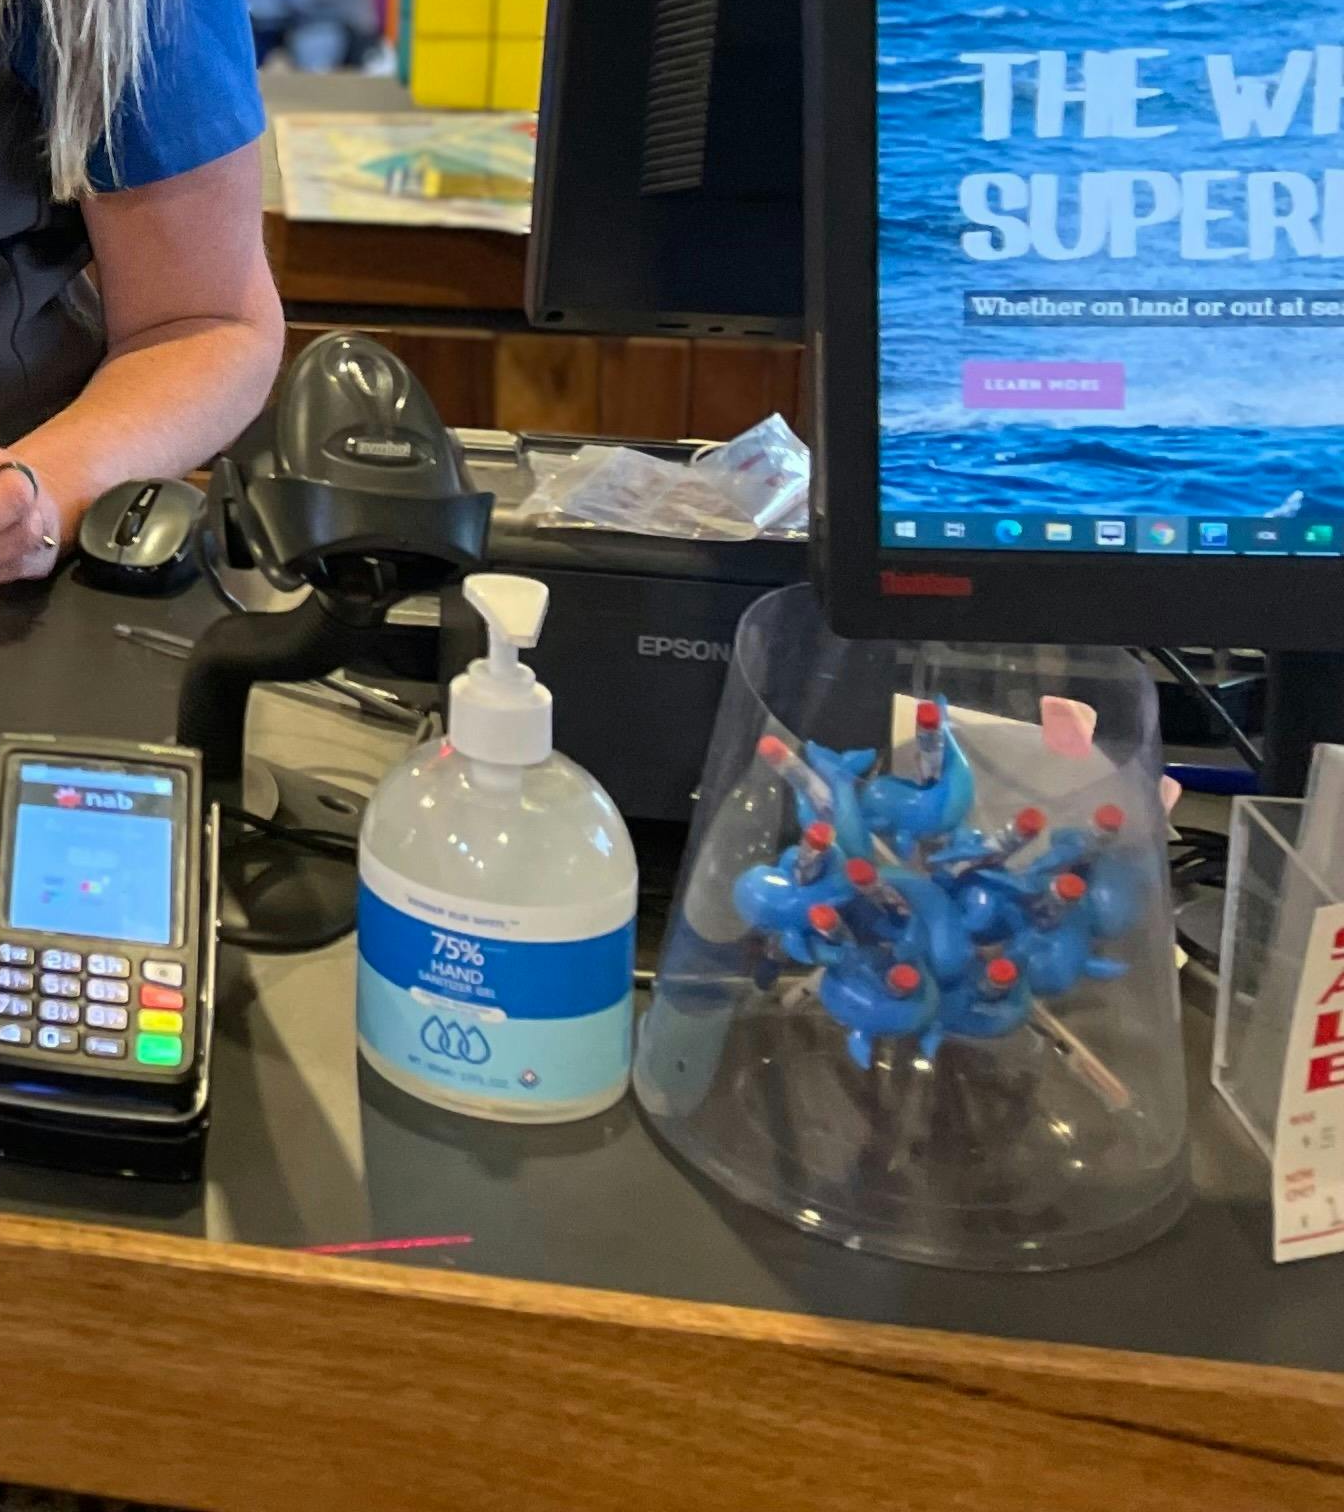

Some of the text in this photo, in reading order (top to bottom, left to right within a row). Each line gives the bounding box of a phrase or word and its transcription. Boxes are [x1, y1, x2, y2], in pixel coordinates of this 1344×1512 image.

[959, 47, 1178, 141] THE
[971, 296, 1086, 317] Whether
[1090, 300, 1124, 317] on
[1130, 296, 1189, 317] land
[1195, 300, 1226, 317] or
[1230, 297, 1274, 317] out
[1280, 297, 1305, 317] at
[983, 378, 1101, 392] LEARN MORE
[637, 635, 731, 662] EPSON
[85, 792, 134, 810] nab
[430, 930, 485, 966] 75%
[430, 959, 484, 985] HAND
